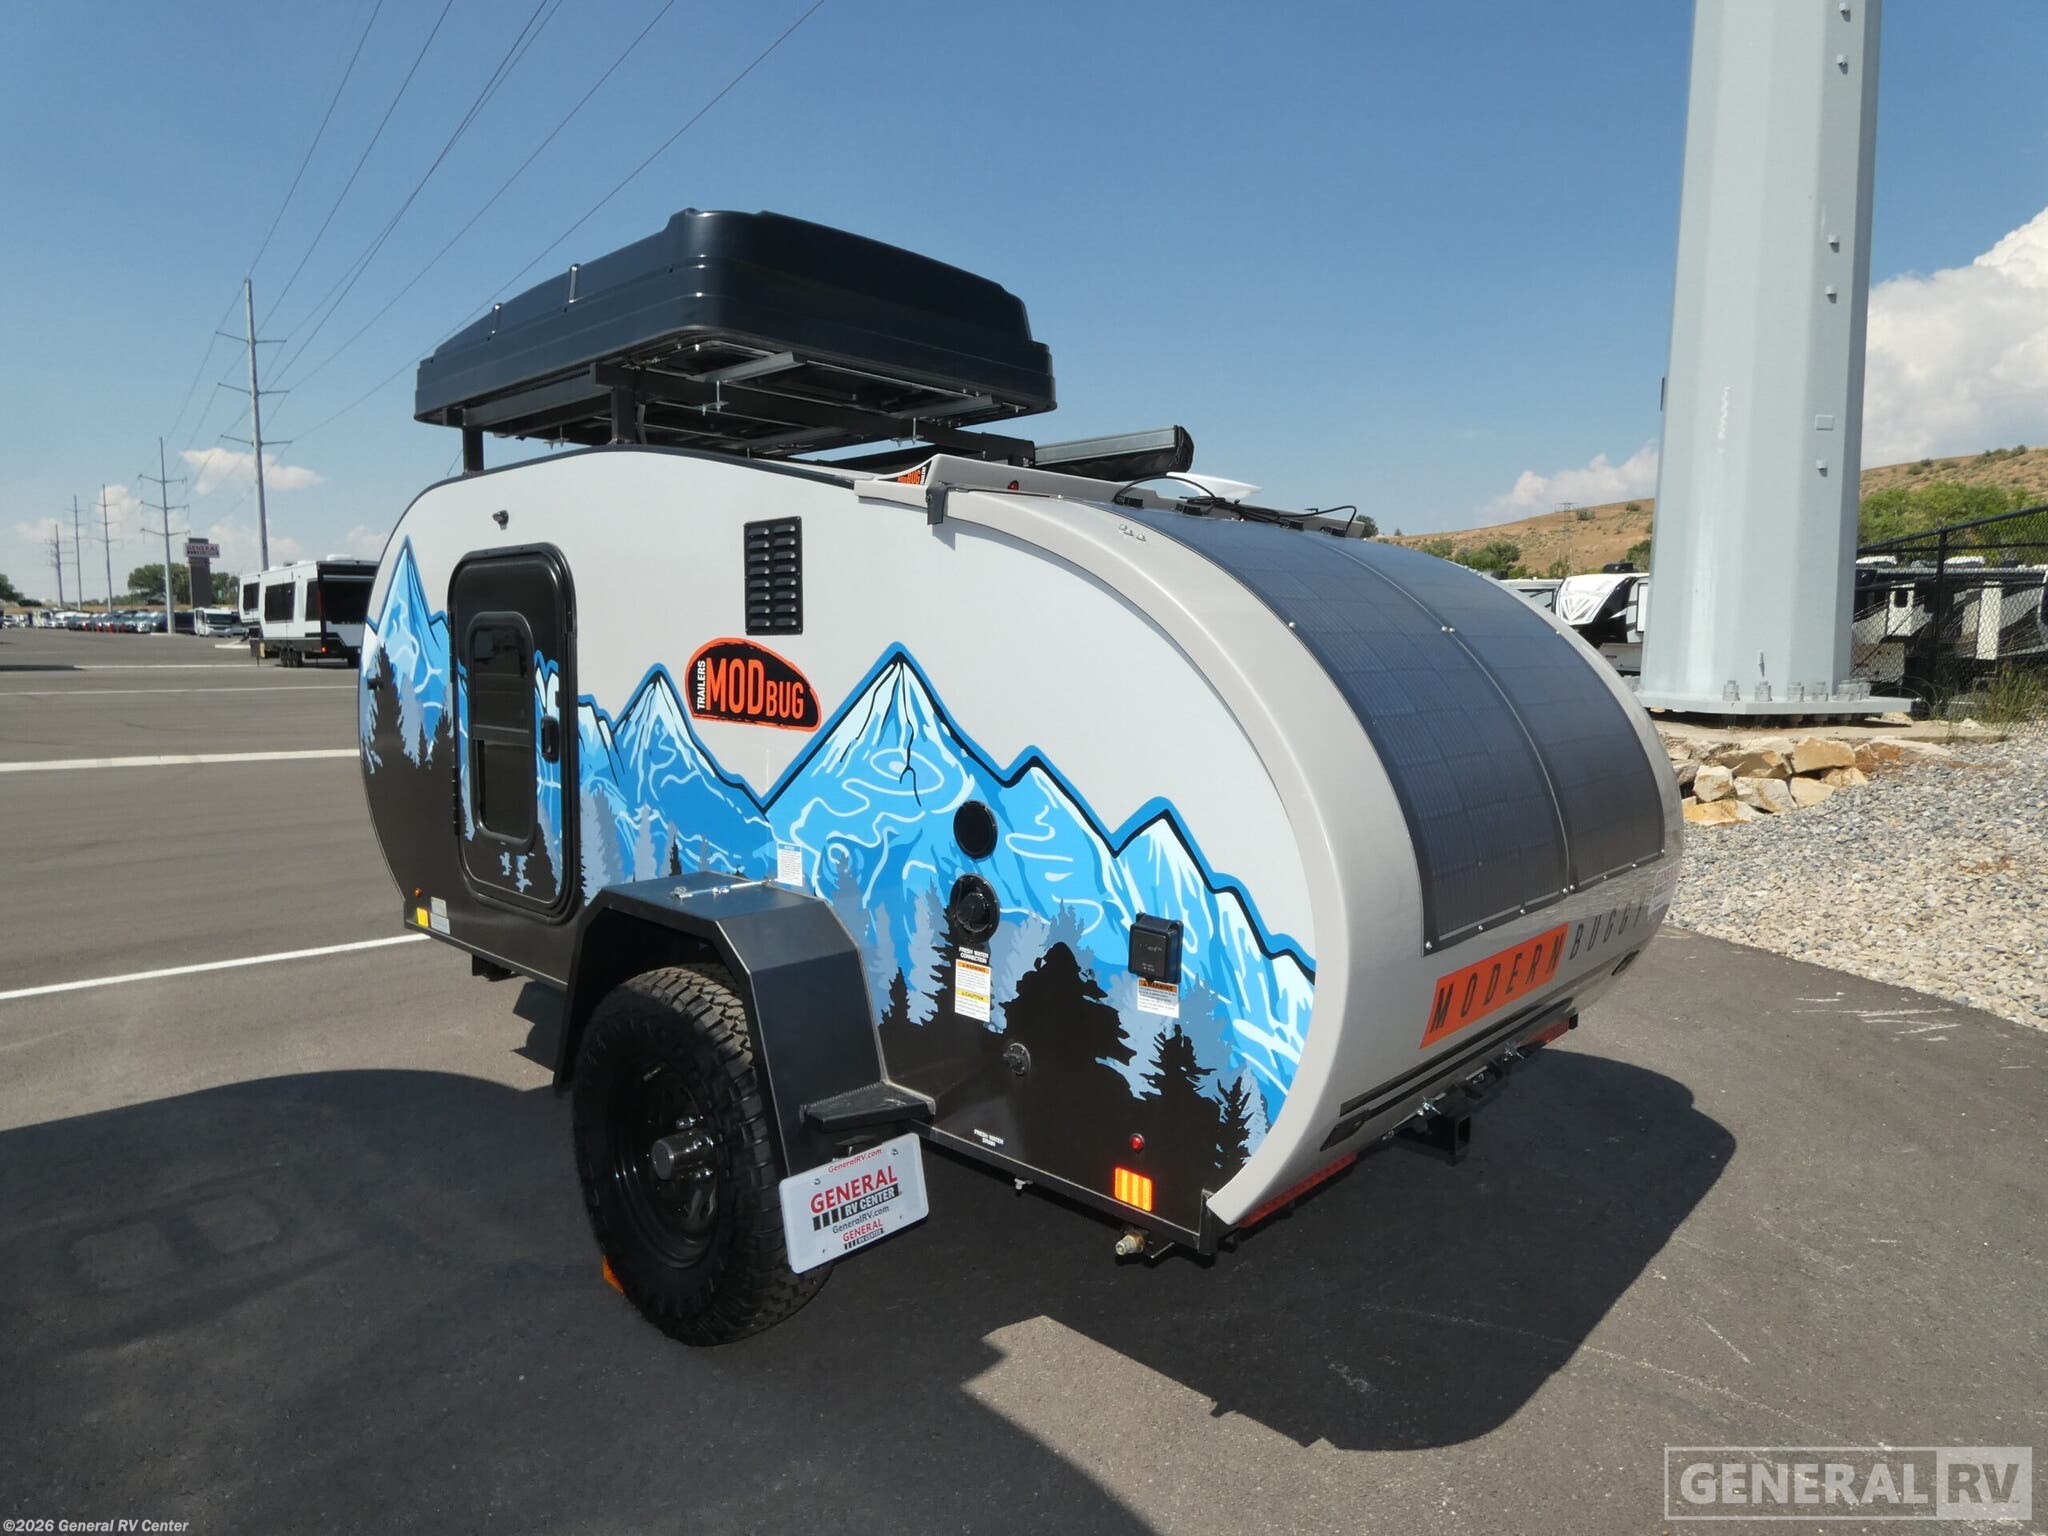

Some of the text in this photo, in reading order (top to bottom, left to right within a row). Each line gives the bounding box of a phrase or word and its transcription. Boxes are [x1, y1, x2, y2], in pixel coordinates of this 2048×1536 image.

[697, 660, 706, 710] TRAILERS
[1430, 932, 1564, 1033] MODERN
[828, 1148, 883, 1173] GeneralRV.com
[810, 1165, 898, 1214] GENERAL
[845, 1187, 895, 1217] RV CENTER
[832, 1205, 890, 1234] GeneralRV.com
[842, 1218, 884, 1242] GENERAL
